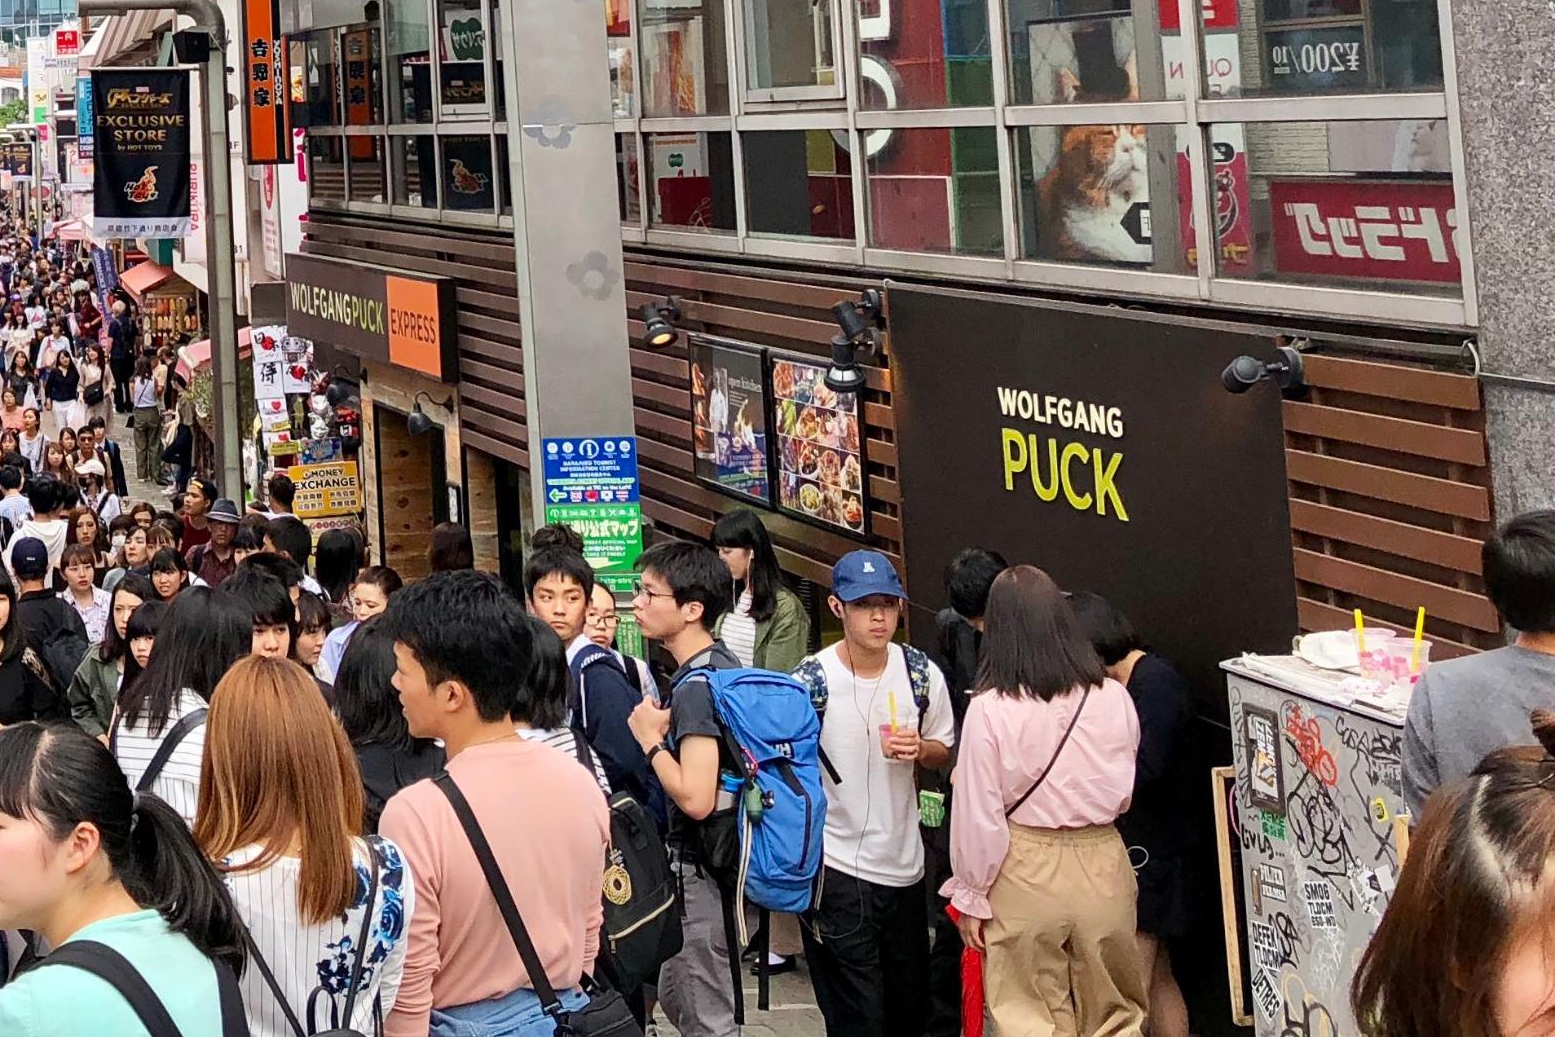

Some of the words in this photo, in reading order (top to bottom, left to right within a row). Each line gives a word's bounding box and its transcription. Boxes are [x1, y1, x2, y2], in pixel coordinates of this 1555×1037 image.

[251, 37, 270, 107] 吉野家
[272, 39, 283, 105] YOSHINOYA
[96, 114, 185, 128] EXCLUSIVE
[113, 129, 168, 142] STORE
[289, 280, 353, 327] WOLFGANG
[349, 295, 385, 336] PUCK
[390, 307, 437, 345] EXPRESS
[997, 386, 1125, 440] WOLFGANG
[294, 477, 356, 490] EXCHANGE
[311, 468, 344, 478] MONEY
[1001, 427, 1130, 522] PUCK
